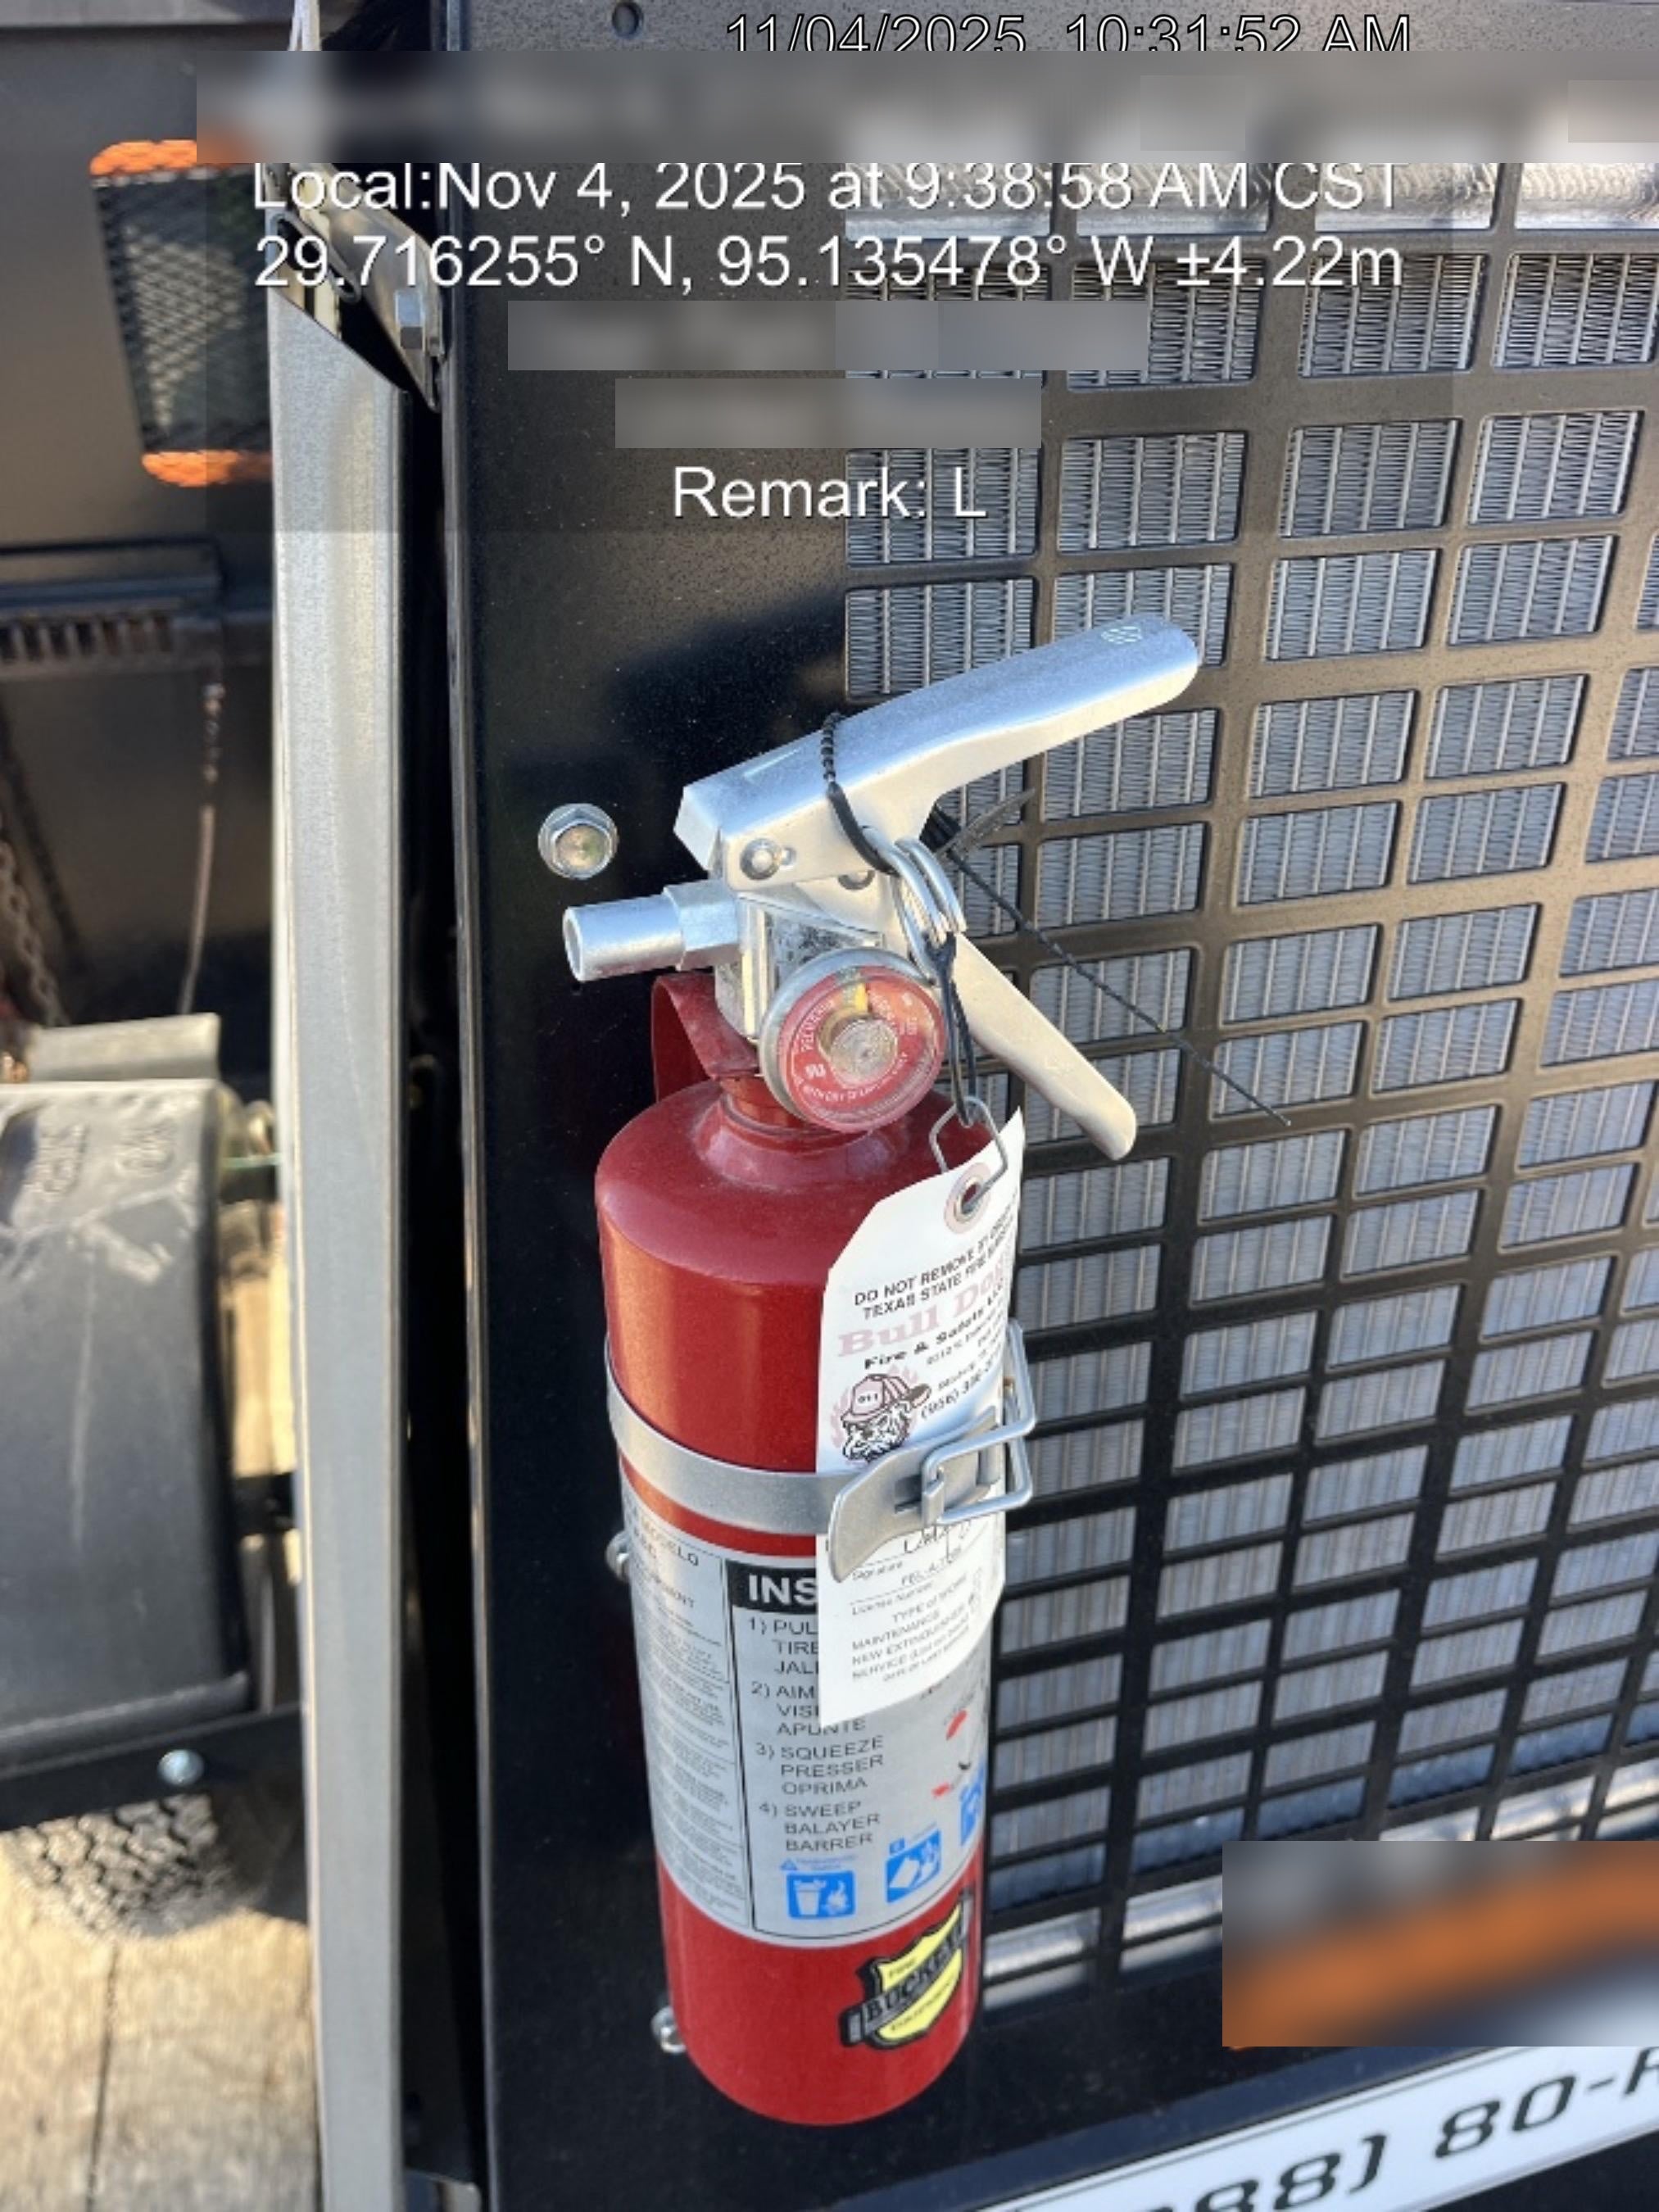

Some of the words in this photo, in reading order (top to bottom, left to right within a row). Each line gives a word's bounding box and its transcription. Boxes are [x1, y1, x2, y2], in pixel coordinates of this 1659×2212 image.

[854, 1289, 879, 1306] DO
[884, 1275, 917, 1298] NOT
[920, 1272, 963, 1302] STATE
[837, 1304, 939, 1357] Bull
[864, 1351, 908, 1370] Fire
[748, 1574, 818, 1606] INS
[749, 1616, 768, 1635] 1)
[751, 1681, 770, 1699] 2)
[775, 1685, 814, 1699] AIM
[777, 1716, 866, 1736] APUNTE
[755, 1742, 775, 1760] 3)
[780, 1735, 884, 1761] SQUEEZE
[780, 1754, 884, 1778] PRESSER
[781, 1776, 869, 1795] OPRIMA
[759, 1802, 777, 1818] 4)
[784, 1801, 862, 1818] SWEEP
[784, 1812, 881, 1834] BALAYER
[785, 1834, 873, 1852] BARRER
